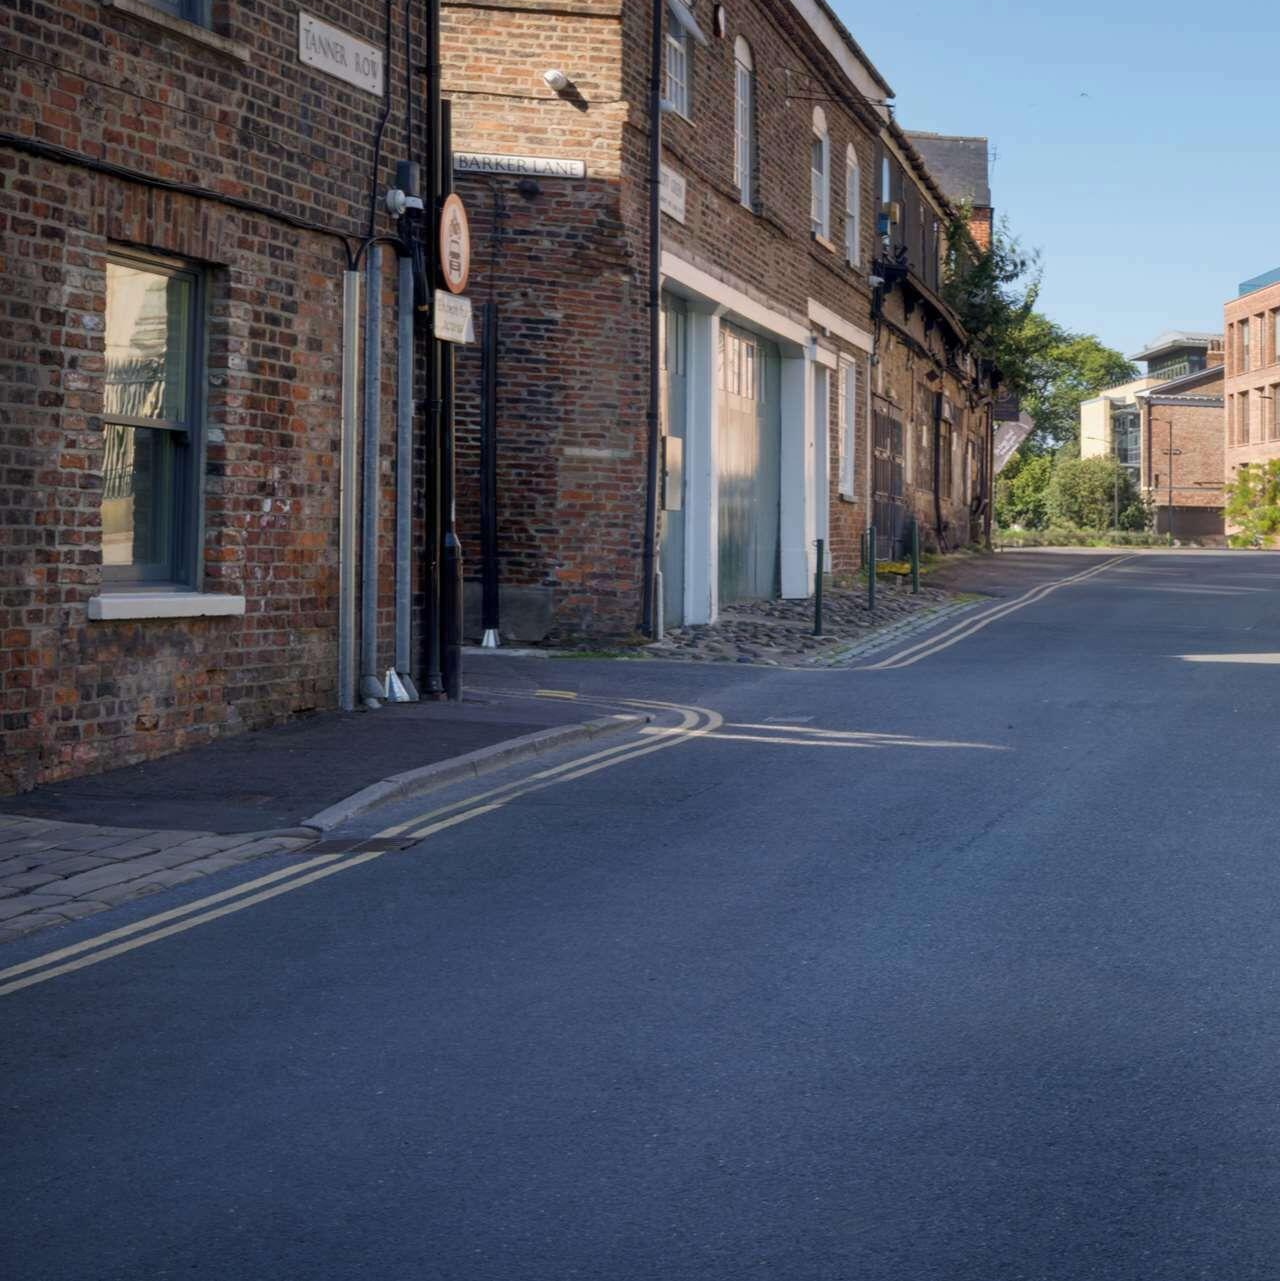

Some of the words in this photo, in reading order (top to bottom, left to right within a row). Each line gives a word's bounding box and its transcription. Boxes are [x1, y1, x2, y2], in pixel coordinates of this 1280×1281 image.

[303, 28, 348, 67] TANNER
[355, 52, 380, 79] ROW
[458, 154, 528, 173] BARKER
[532, 159, 580, 176] LANE
